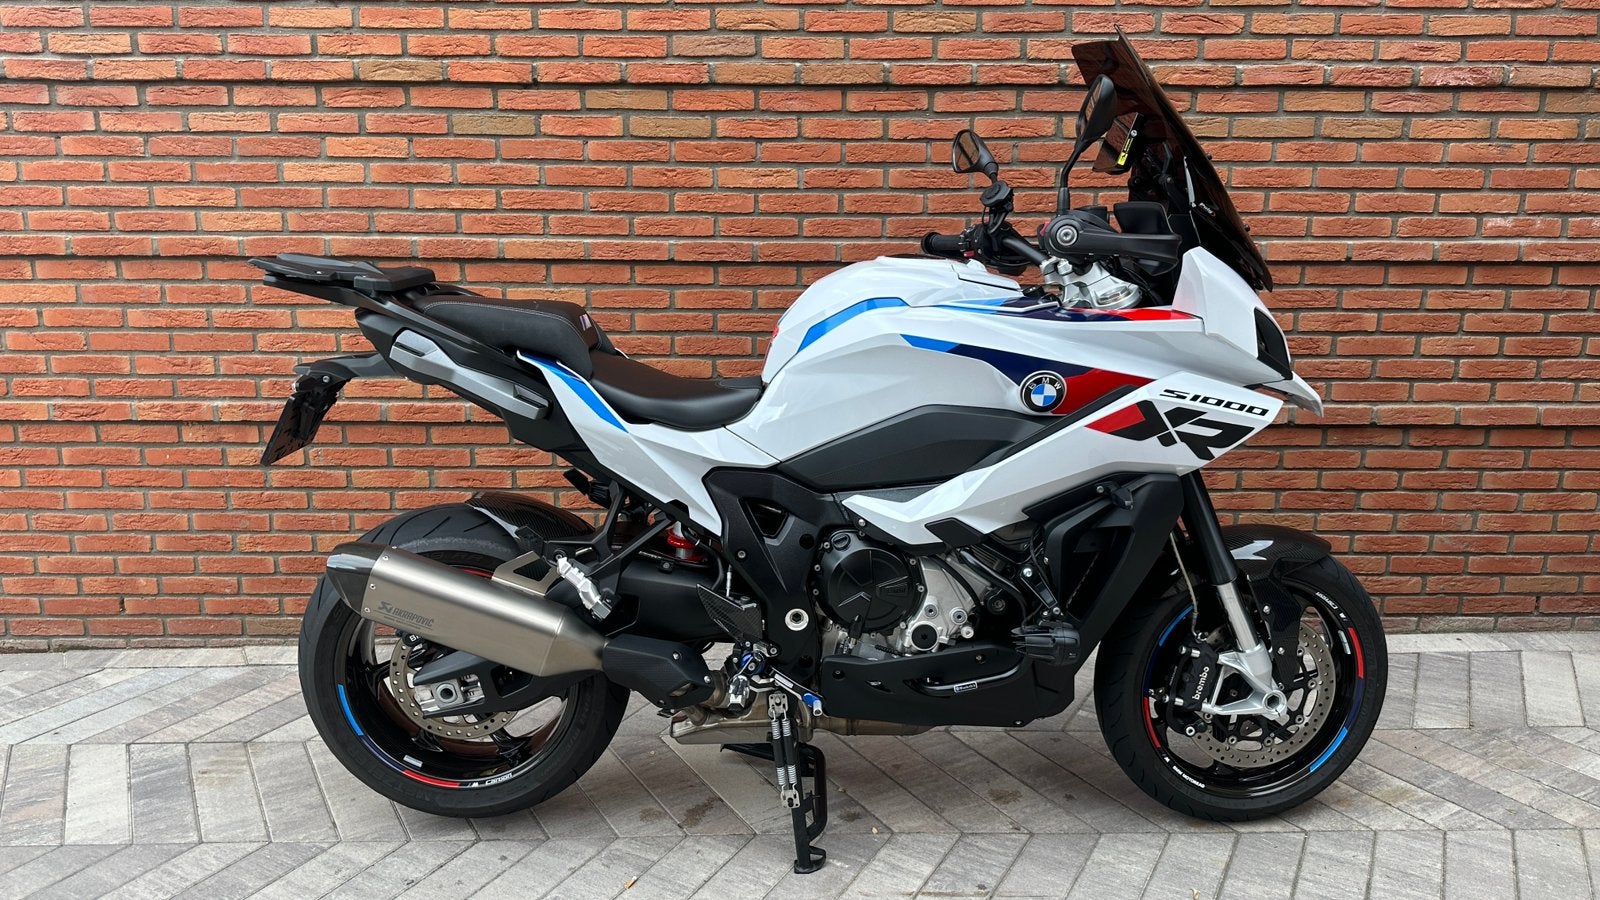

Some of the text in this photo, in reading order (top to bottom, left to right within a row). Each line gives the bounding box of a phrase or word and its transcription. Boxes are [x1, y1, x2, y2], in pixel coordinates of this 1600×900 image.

[1028, 377, 1062, 390] BMW
[1160, 389, 1270, 416] S1000
[1084, 400, 1255, 461] XR
[1192, 666, 1210, 700] brembo
